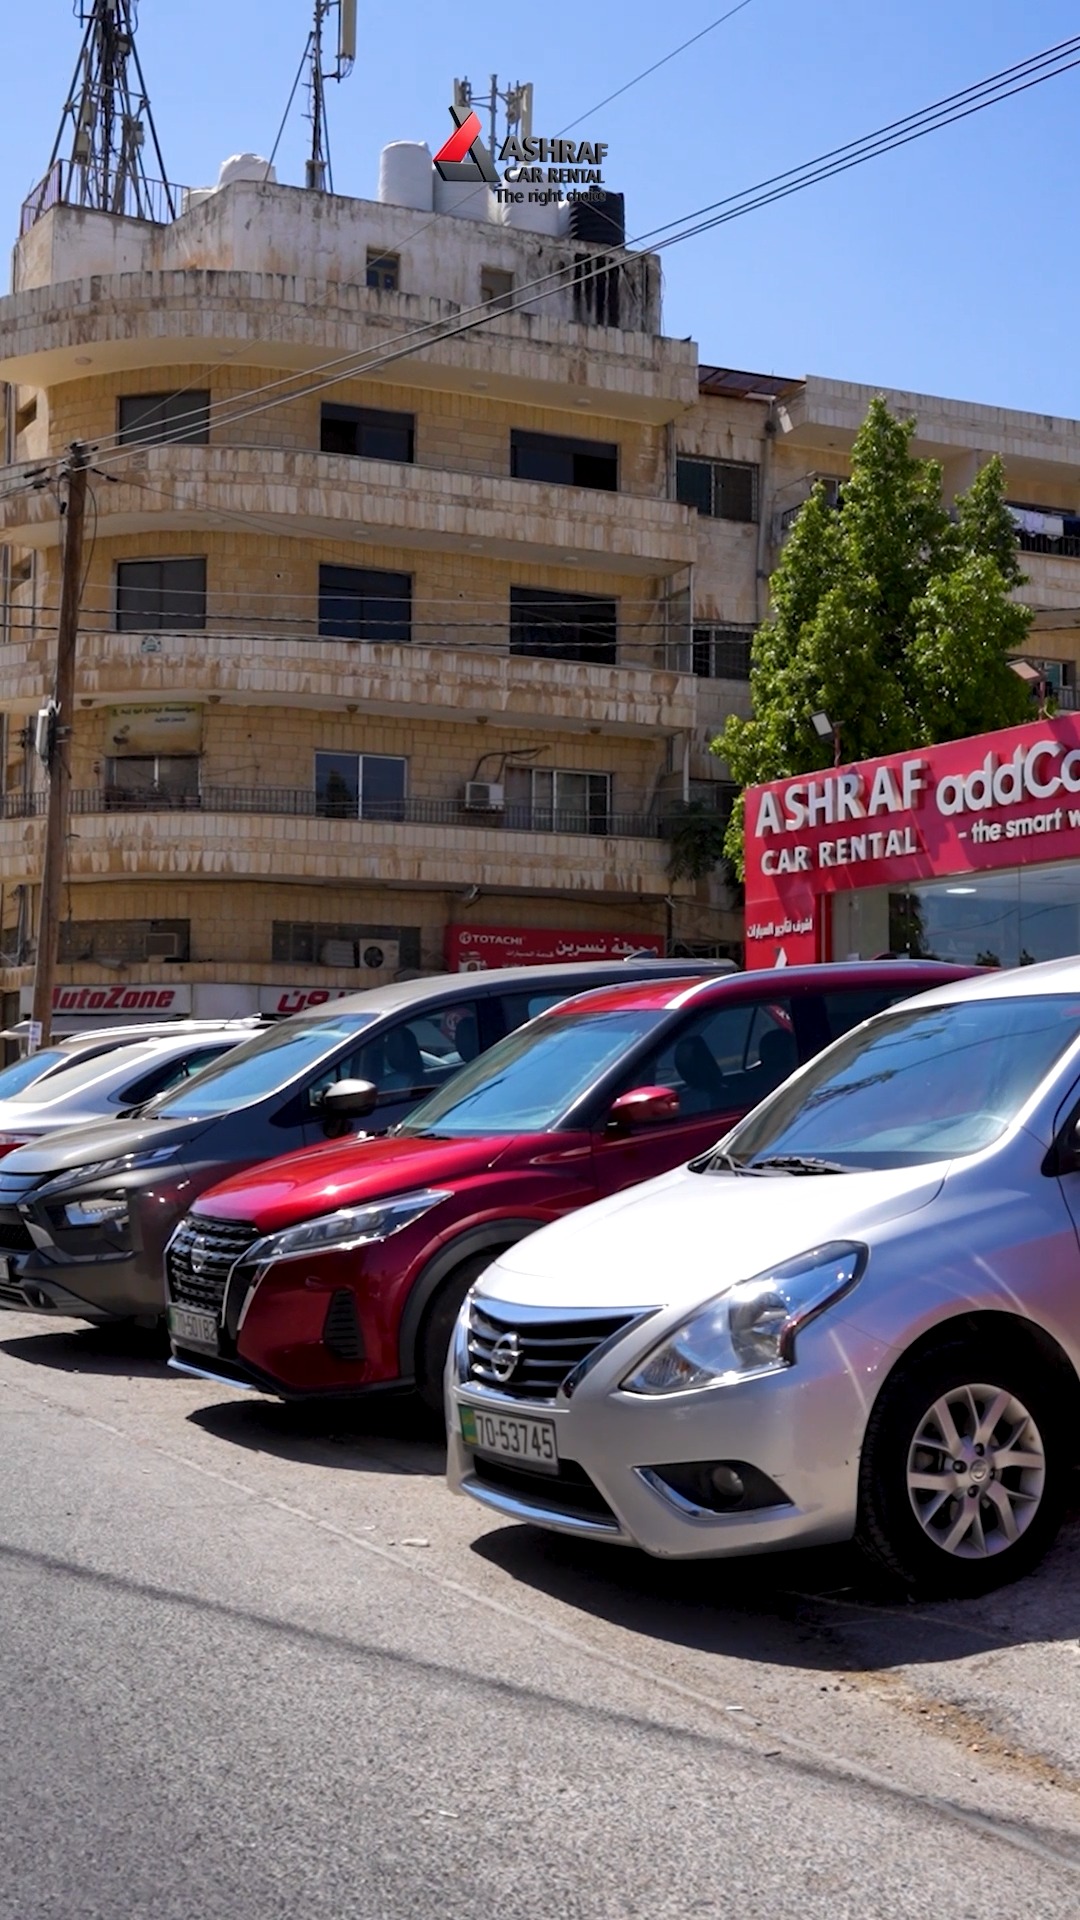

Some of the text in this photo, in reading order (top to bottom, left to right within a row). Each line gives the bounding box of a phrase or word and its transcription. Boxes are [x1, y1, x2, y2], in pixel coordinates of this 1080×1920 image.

[754, 758, 928, 838] ASHRAF
[971, 819, 1002, 843] the
[1005, 807, 1063, 838] smart
[760, 826, 917, 876] CAR RENTAL
[472, 934, 523, 945] TOTACHI
[556, 939, 607, 956] نسرين
[747, 921, 774, 939] السيارات
[475, 1415, 553, 1459] 70-53745
